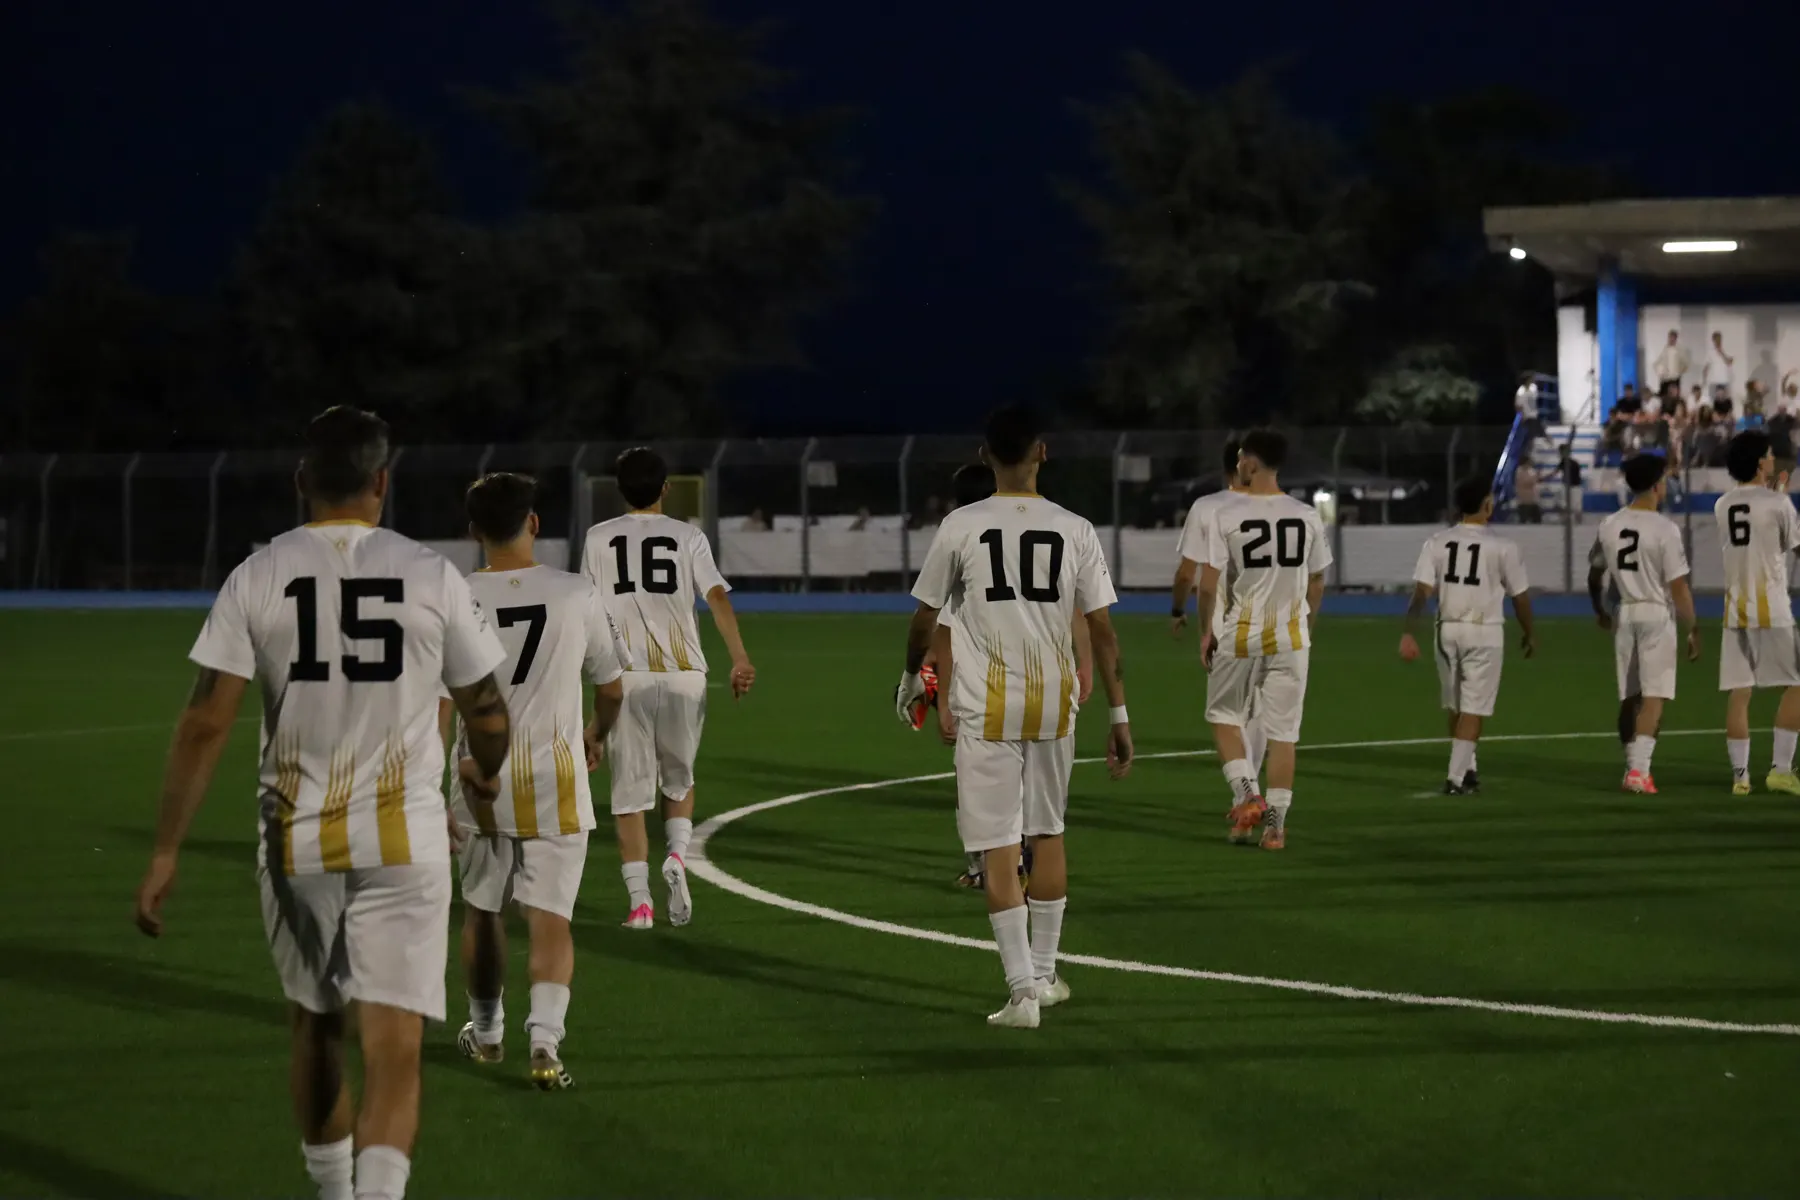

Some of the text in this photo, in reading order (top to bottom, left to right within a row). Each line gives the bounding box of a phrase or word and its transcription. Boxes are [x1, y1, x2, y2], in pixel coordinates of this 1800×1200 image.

[1241, 519, 1305, 567] 20
[1617, 529, 1639, 571] 2
[1729, 504, 1750, 546] 6
[609, 535, 677, 594] 16
[981, 529, 1064, 602] 10
[1444, 541, 1480, 585] 11
[284, 577, 403, 682] 15
[497, 604, 547, 685] 7
